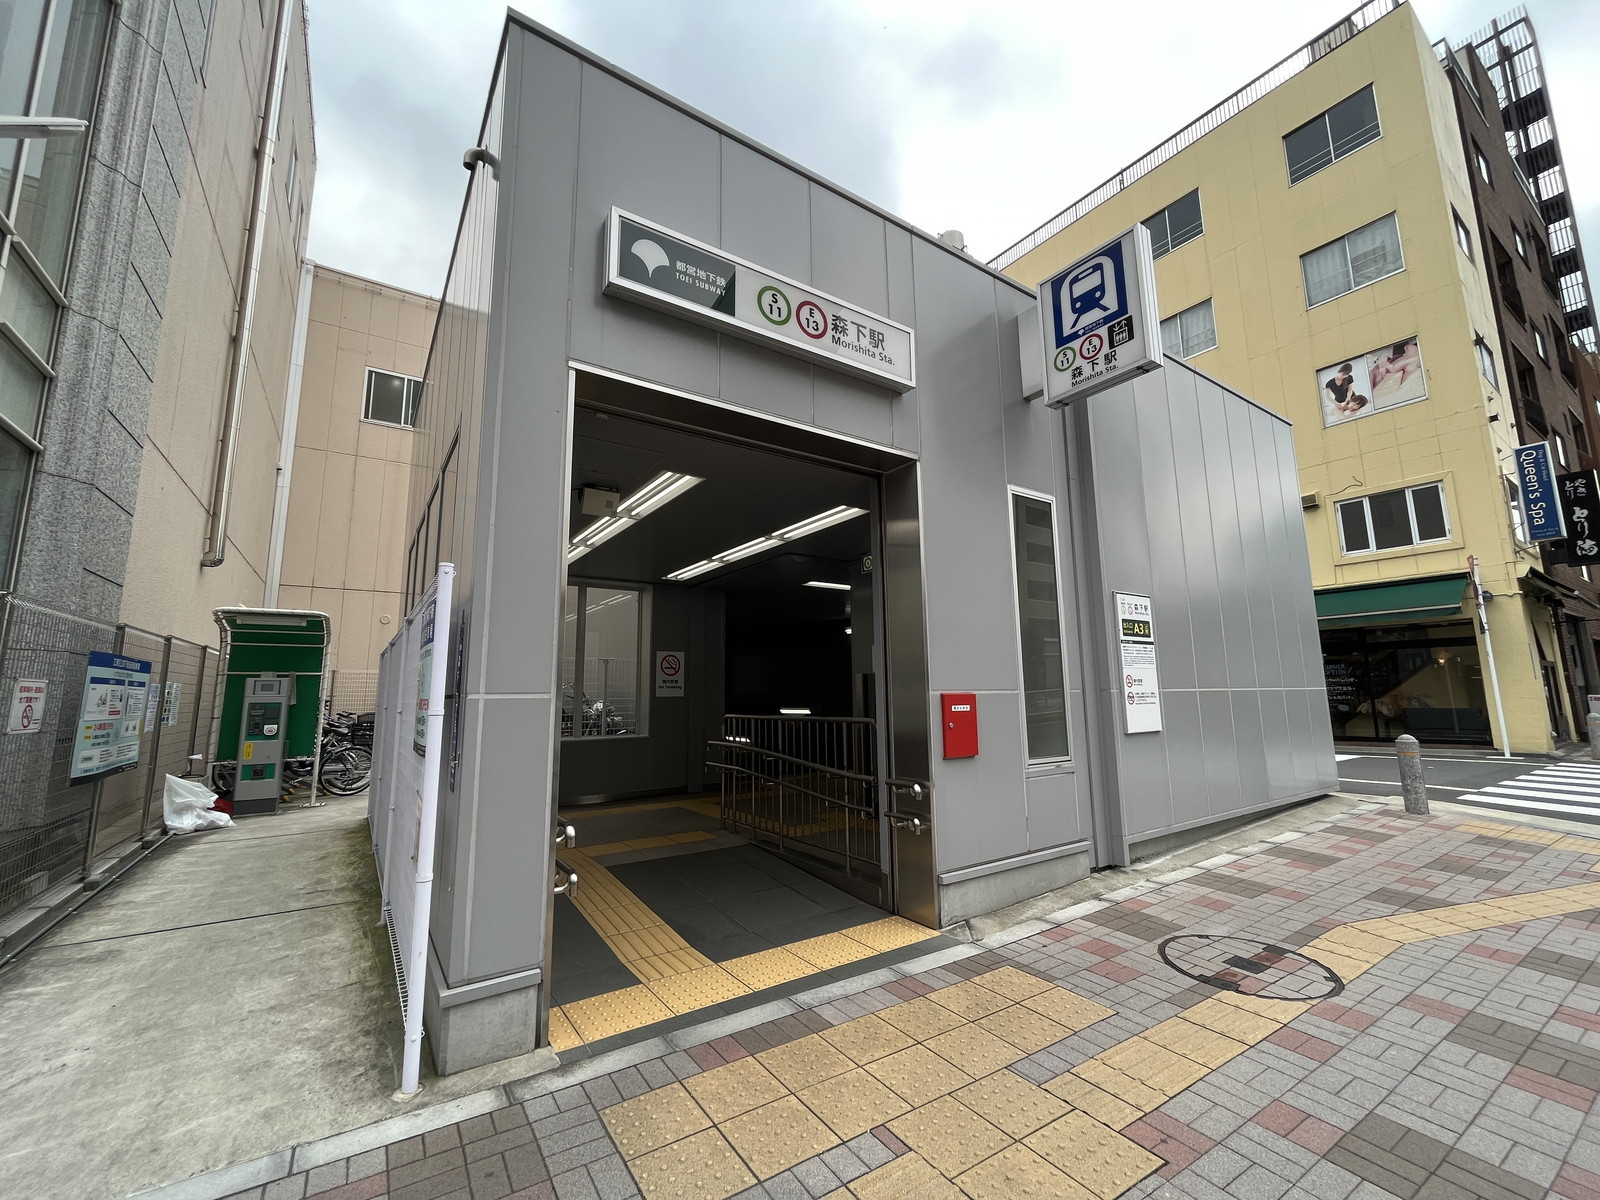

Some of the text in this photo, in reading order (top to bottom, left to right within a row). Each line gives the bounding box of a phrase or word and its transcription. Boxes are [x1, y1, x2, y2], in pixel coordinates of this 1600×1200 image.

[675, 259, 727, 288] 都営地下鉄
[675, 272, 727, 297] TOEI SUBWAY
[771, 292, 779, 304] S
[767, 302, 783, 319] 11
[808, 307, 816, 318] E
[804, 316, 820, 333] 13
[831, 313, 886, 352] 森下駅
[831, 336, 895, 367] Morishita Sta.
[1086, 345, 1098, 355] 13
[1060, 357, 1070, 368] 11
[1071, 349, 1118, 380] 森下駅
[1071, 364, 1119, 388] Morishita Sta.
[1520, 449, 1542, 500] Queen's
[1528, 501, 1546, 526] Spa
[1134, 622, 1144, 635] A3
